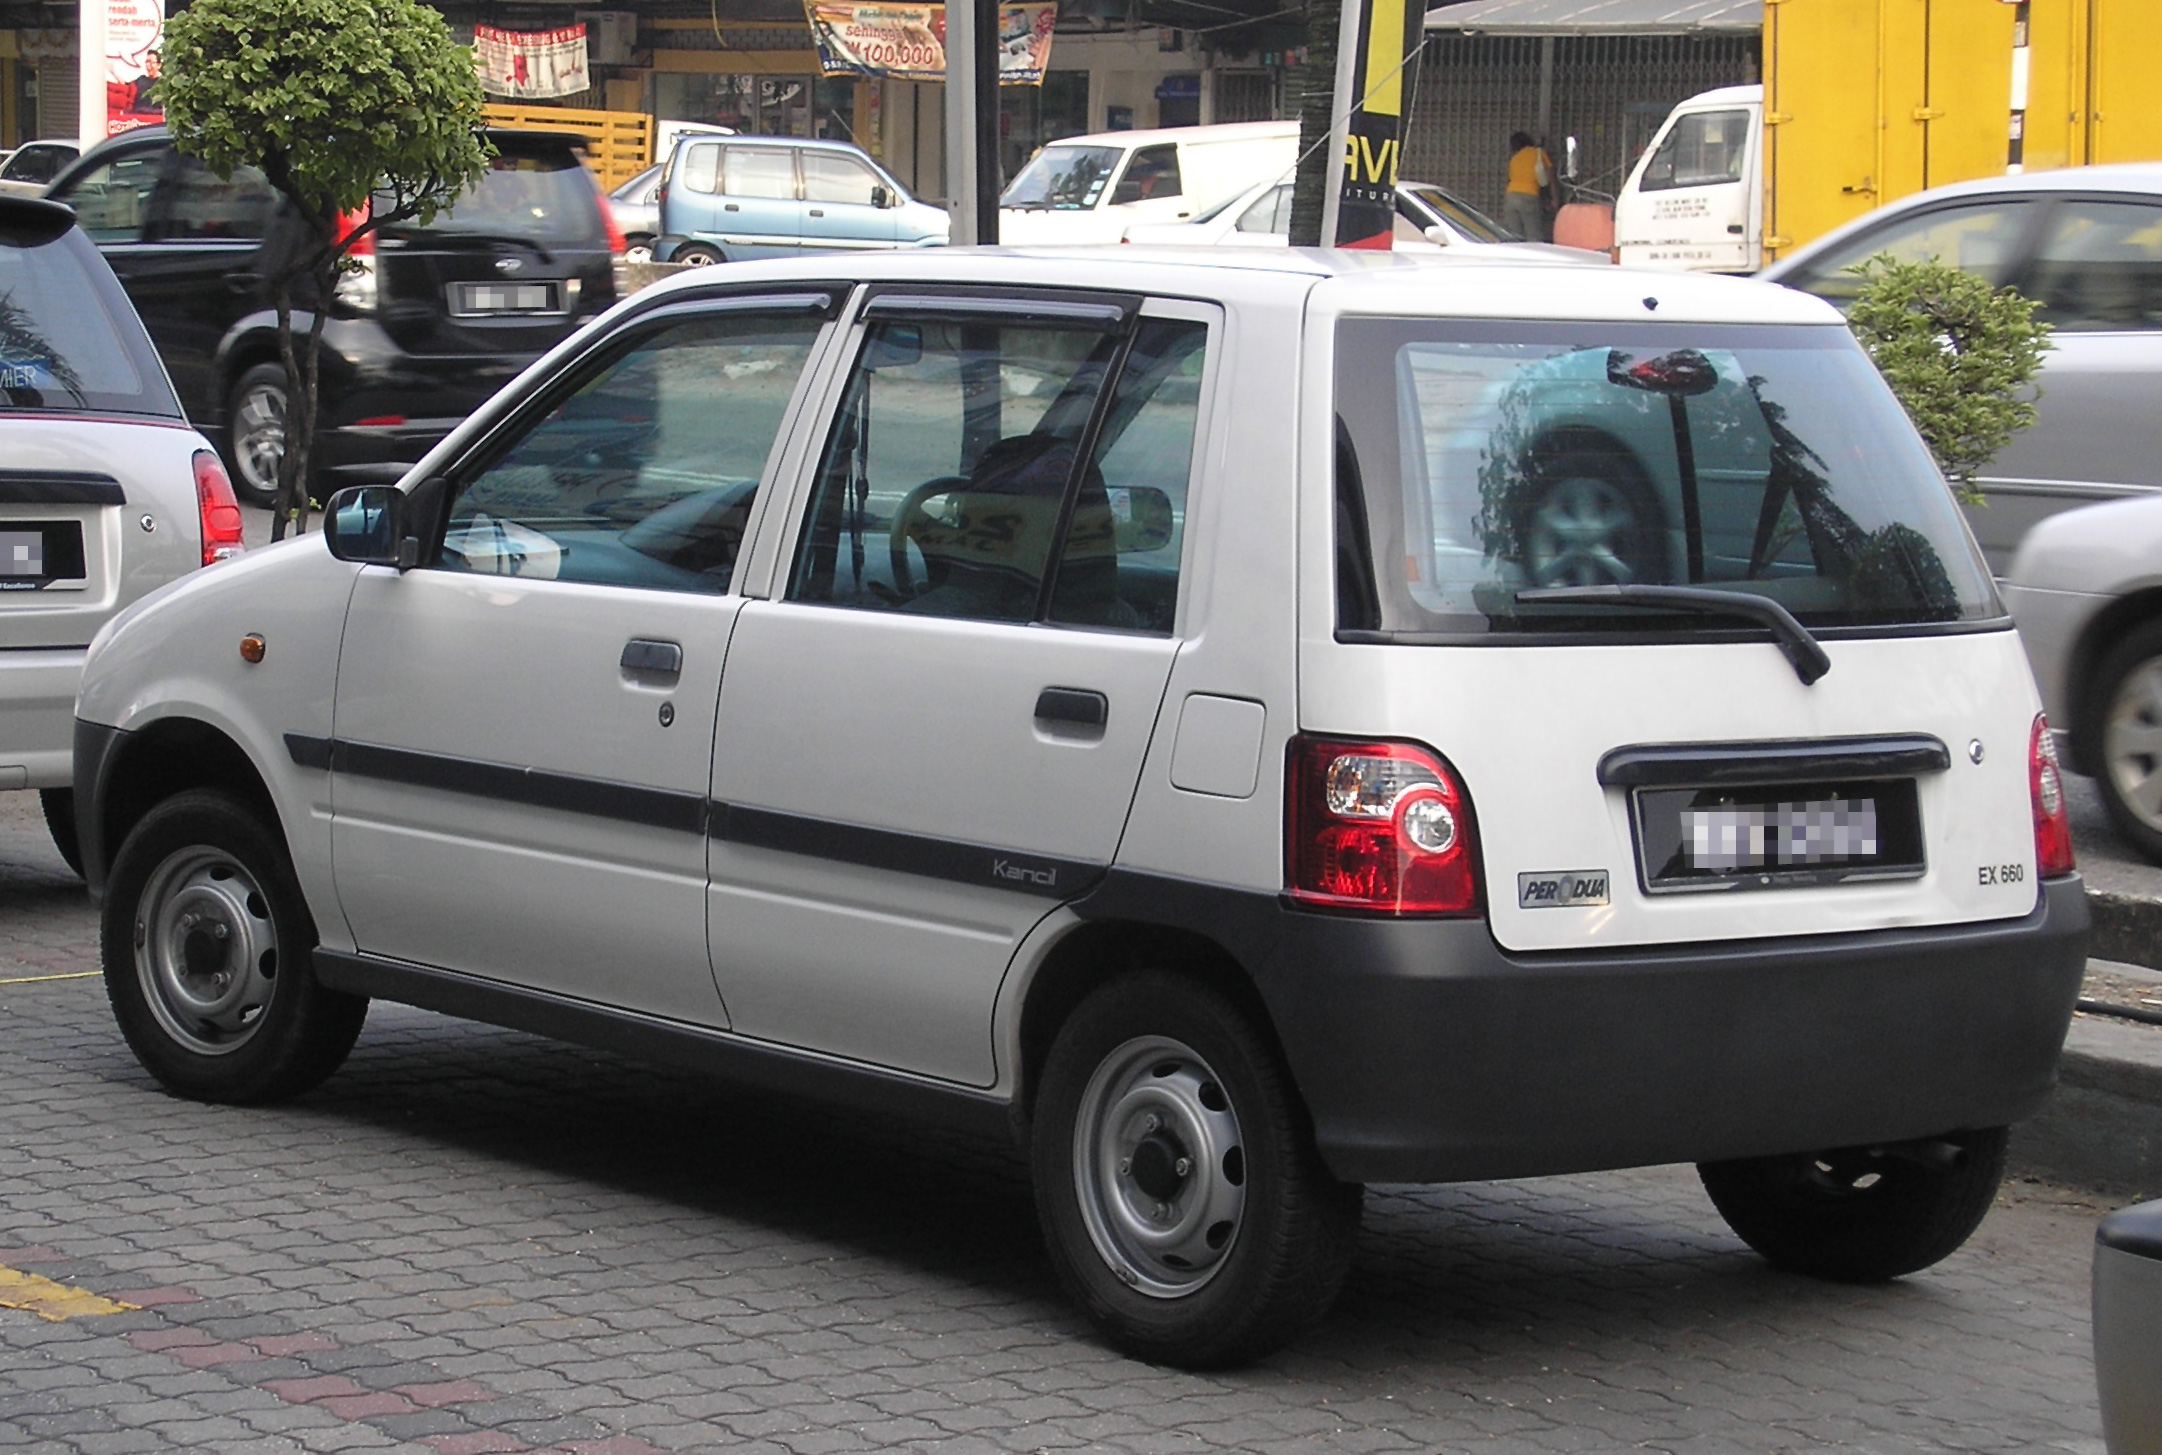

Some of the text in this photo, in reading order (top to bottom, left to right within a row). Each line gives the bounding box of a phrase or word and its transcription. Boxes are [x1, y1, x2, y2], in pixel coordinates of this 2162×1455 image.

[863, 43, 933, 66] 100,000
[993, 858, 1057, 886] Kancil
[1978, 863, 2023, 885] EX 660
[1523, 875, 1605, 903] PERODUA
